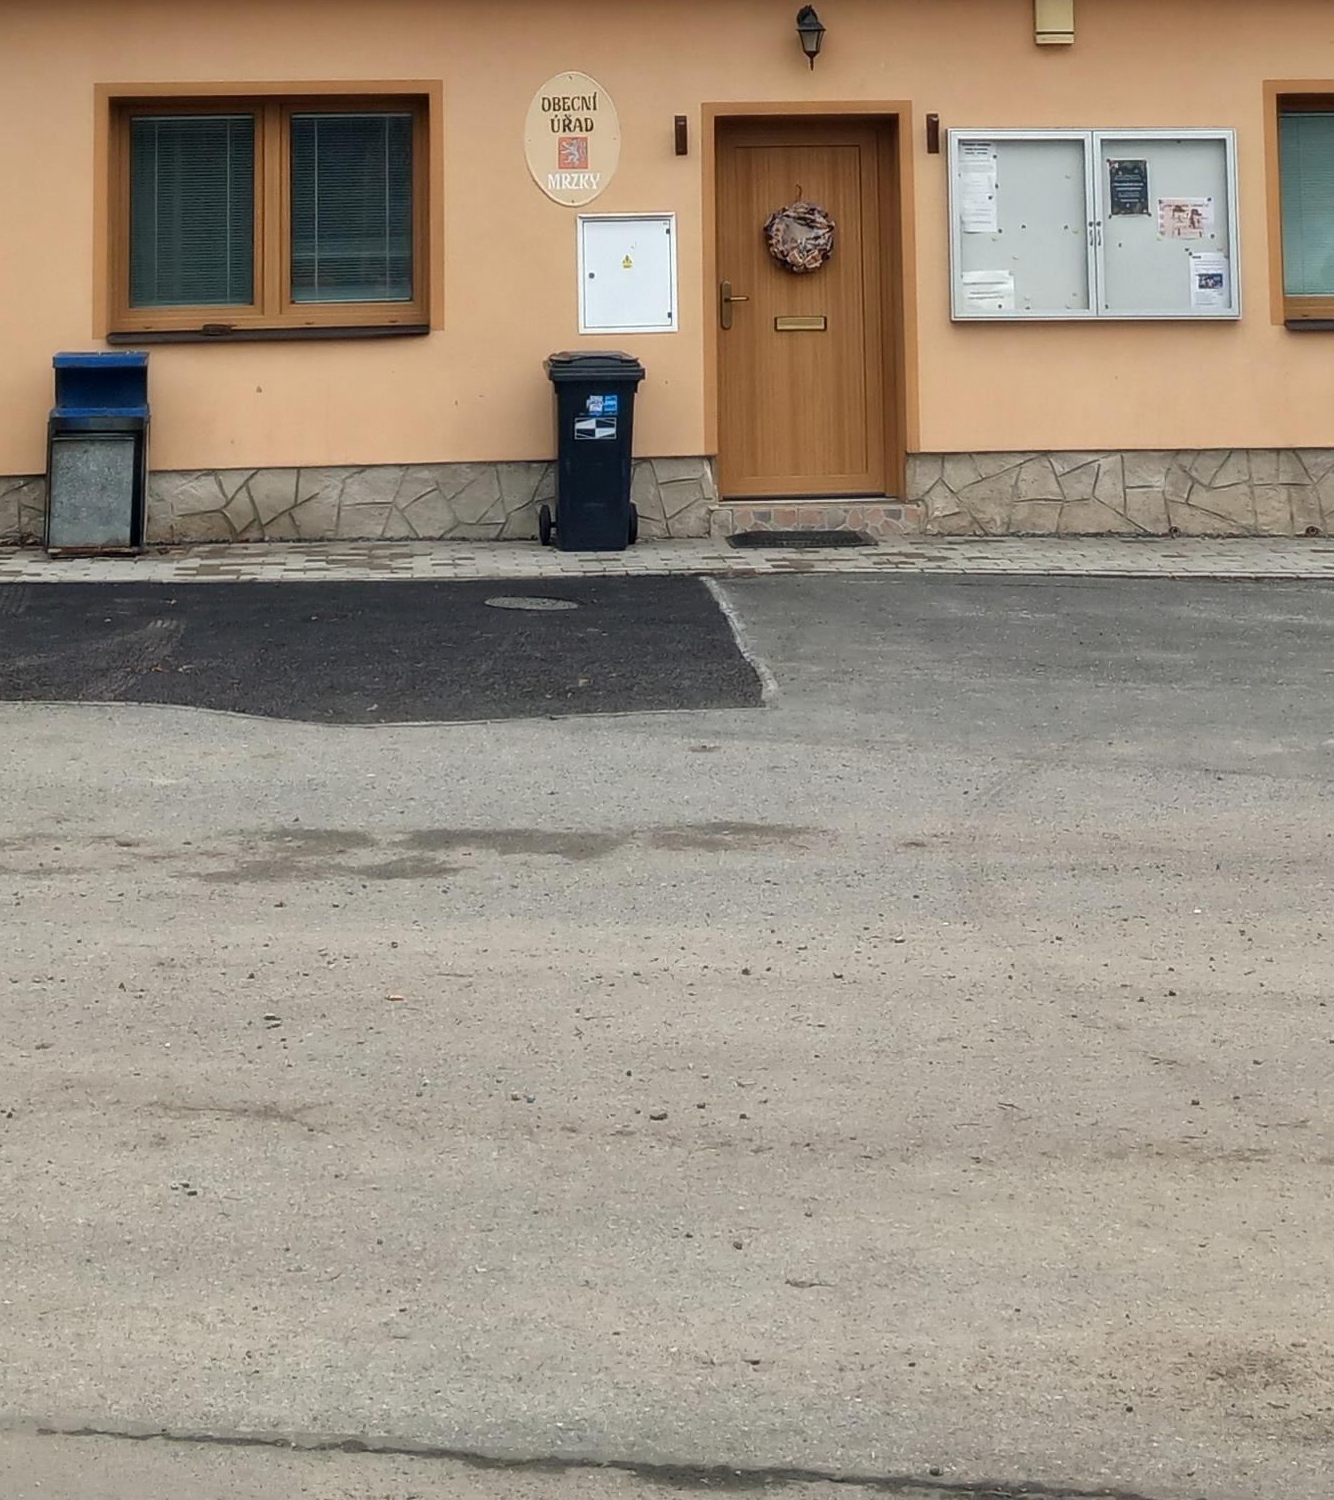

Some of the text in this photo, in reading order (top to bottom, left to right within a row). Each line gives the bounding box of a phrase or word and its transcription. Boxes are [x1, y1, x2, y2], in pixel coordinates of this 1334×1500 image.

[540, 92, 598, 112] OBECNÍ
[550, 114, 594, 133] ÚŘAD
[547, 172, 601, 190] MRZKY
